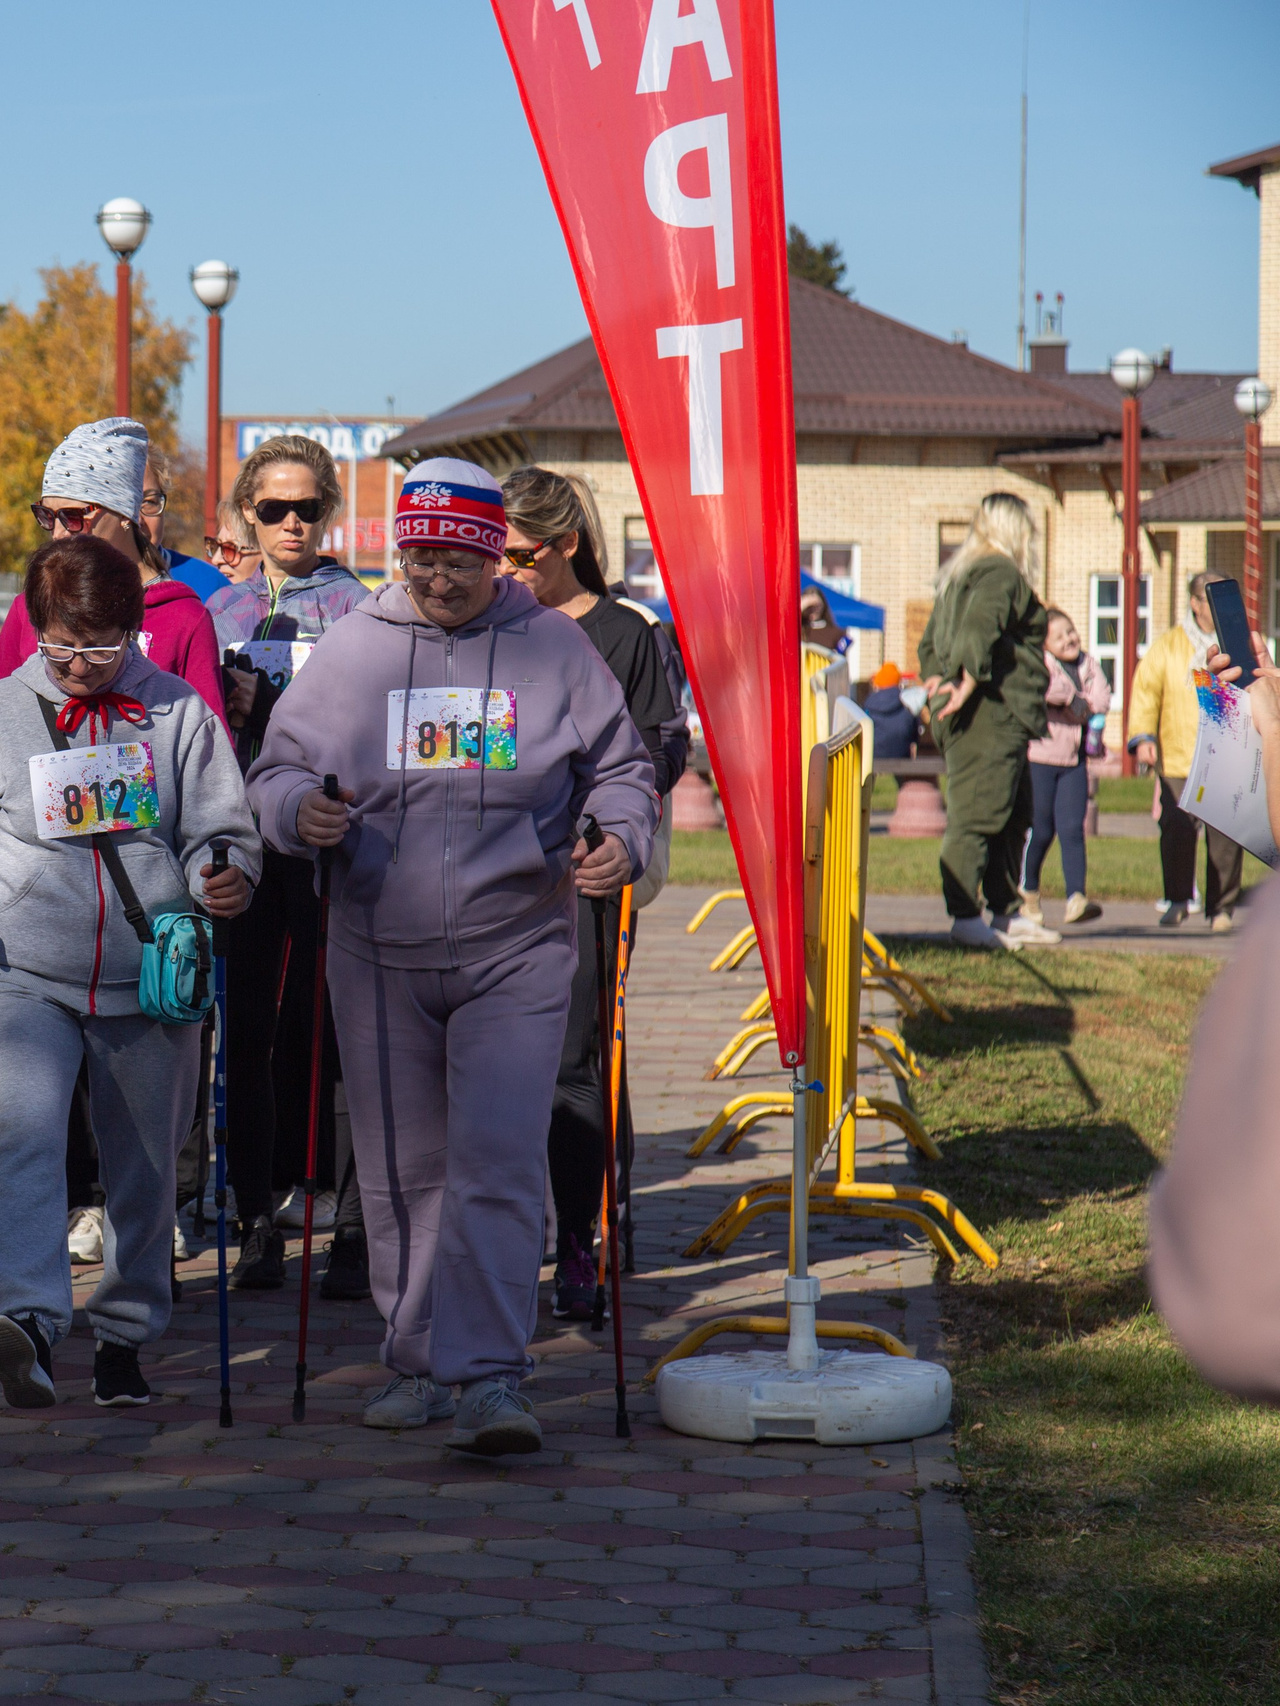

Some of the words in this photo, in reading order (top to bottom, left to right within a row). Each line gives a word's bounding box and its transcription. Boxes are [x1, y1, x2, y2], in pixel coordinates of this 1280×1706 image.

[418, 720, 482, 759] 813
[63, 778, 131, 825] 812
[615, 930, 628, 1053] EXEL
